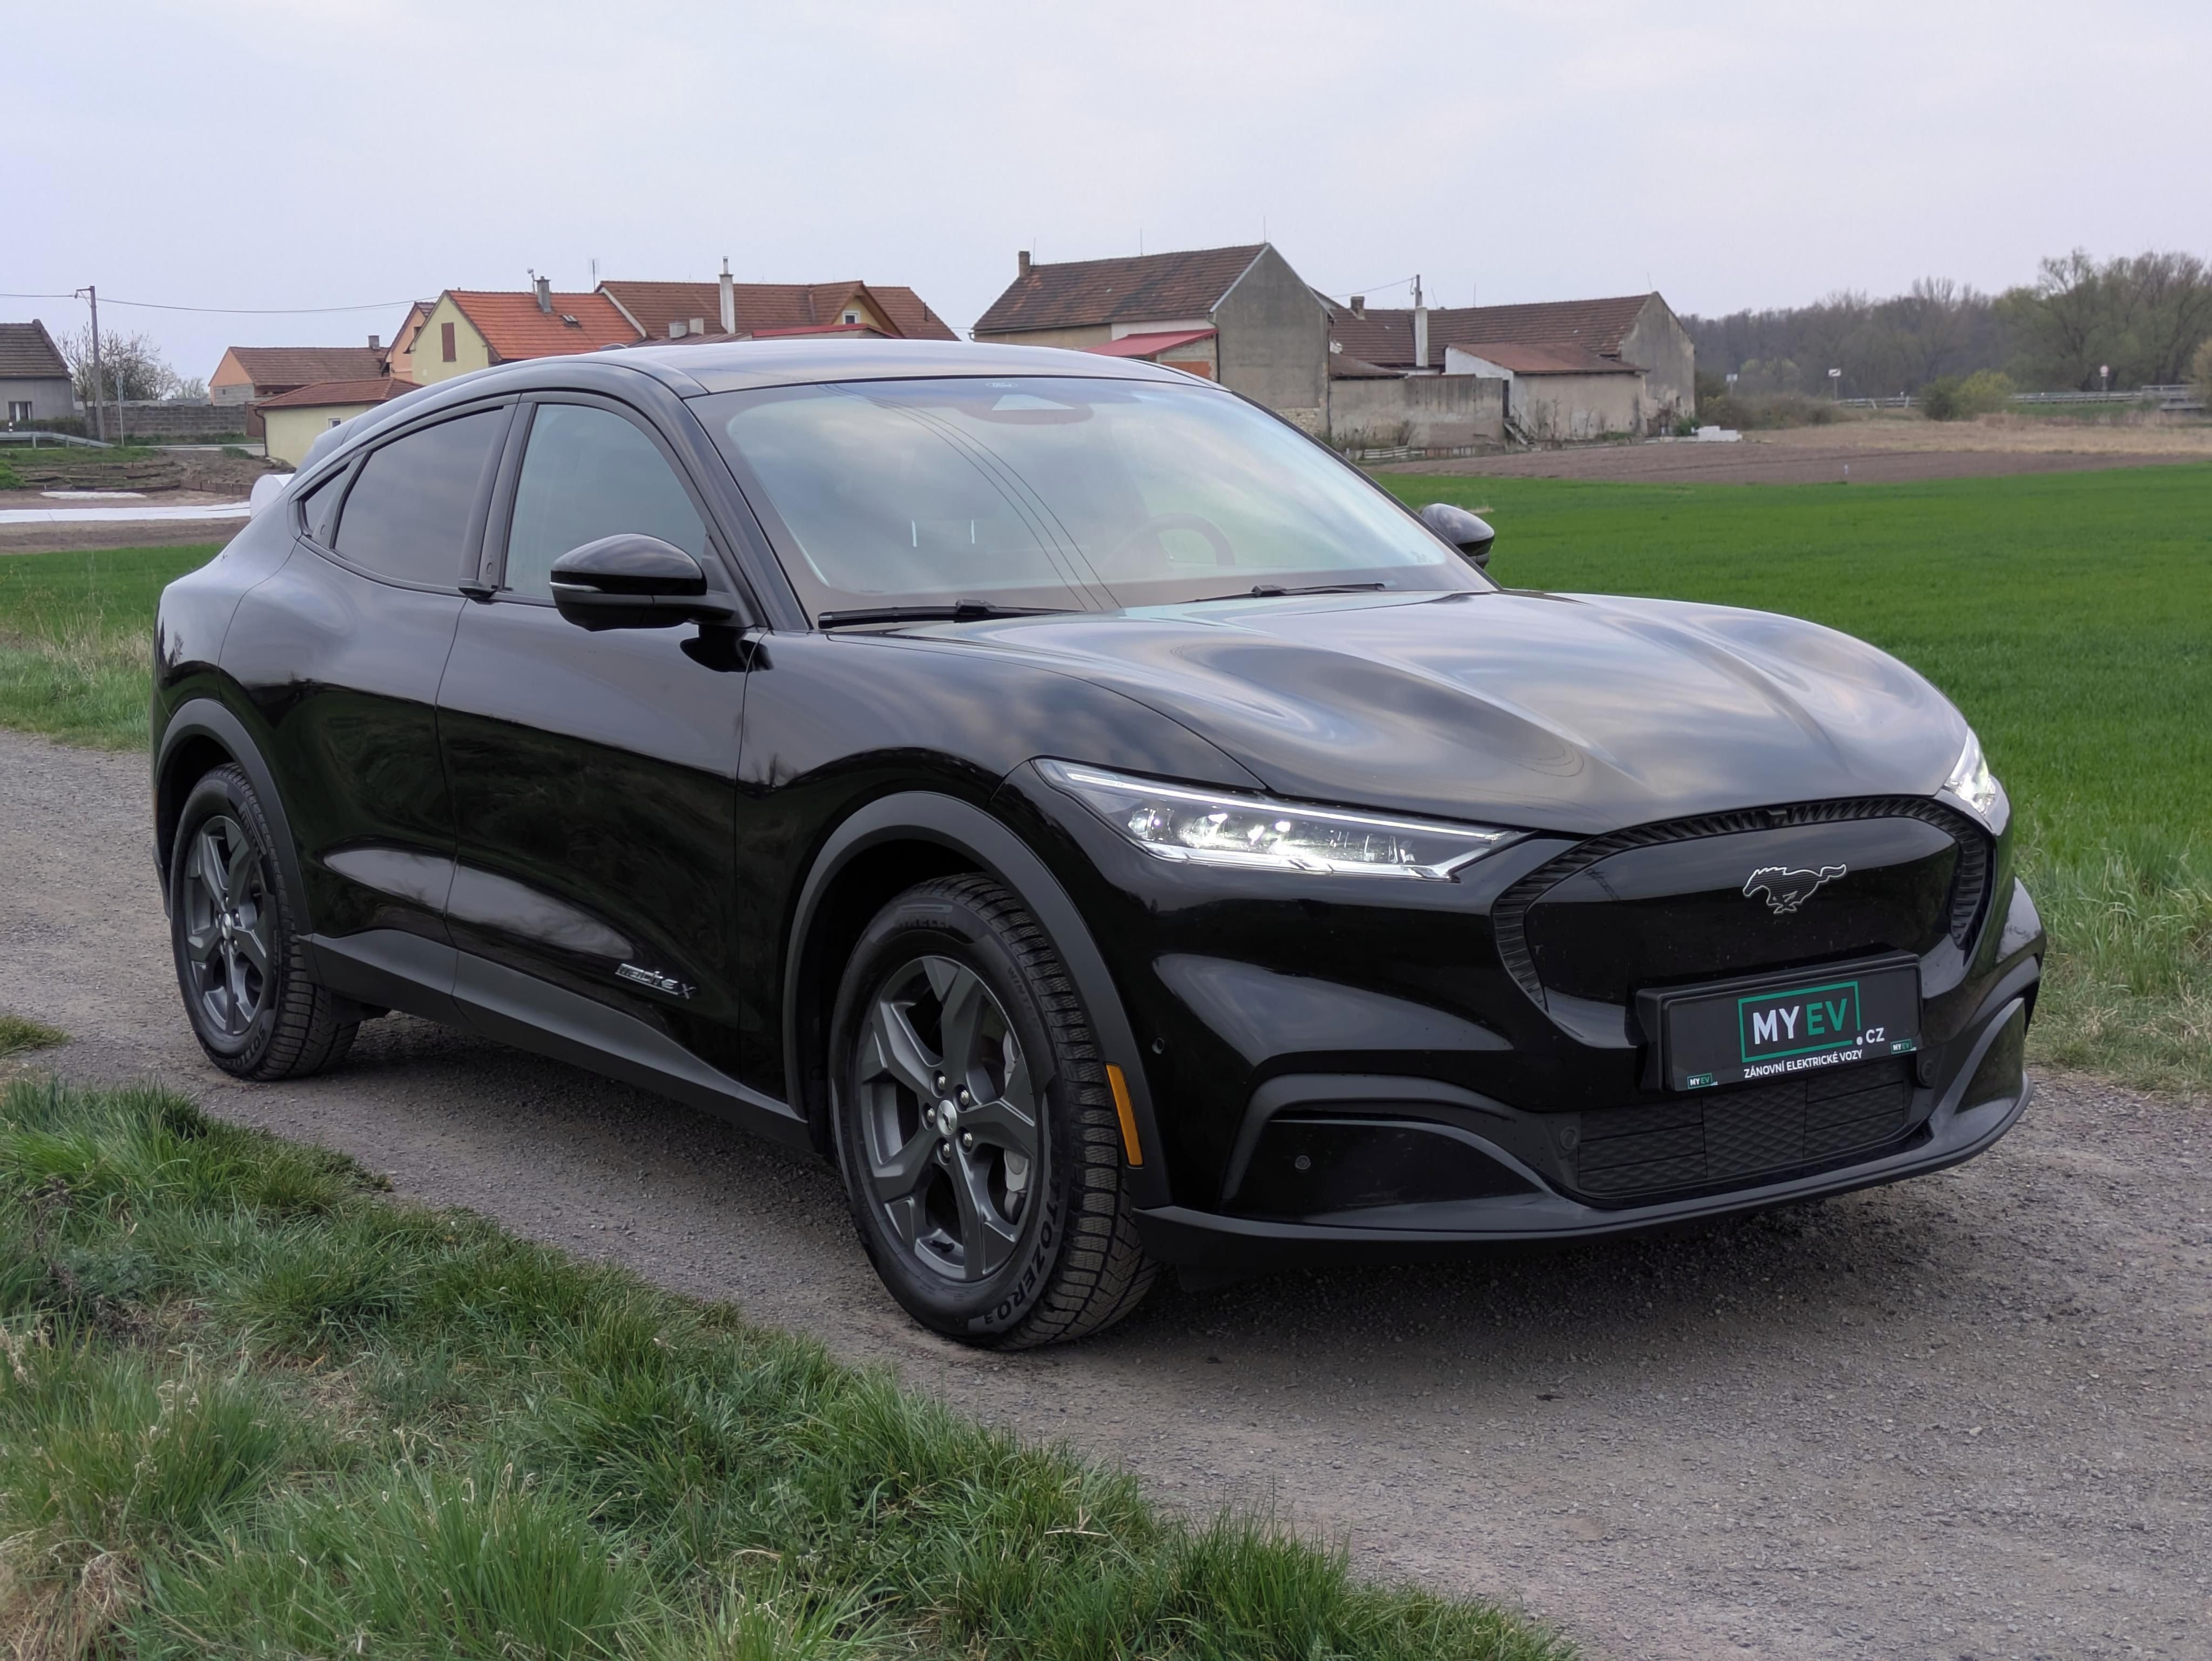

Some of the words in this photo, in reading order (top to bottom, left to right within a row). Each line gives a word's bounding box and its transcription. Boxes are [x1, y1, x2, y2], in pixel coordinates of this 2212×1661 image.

[1743, 1060, 1785, 1079] ZÁNOVNÍ
[1786, 1051, 1838, 1071] ELEKTRICKÉ
[1839, 1049, 1863, 1062] VOZY
